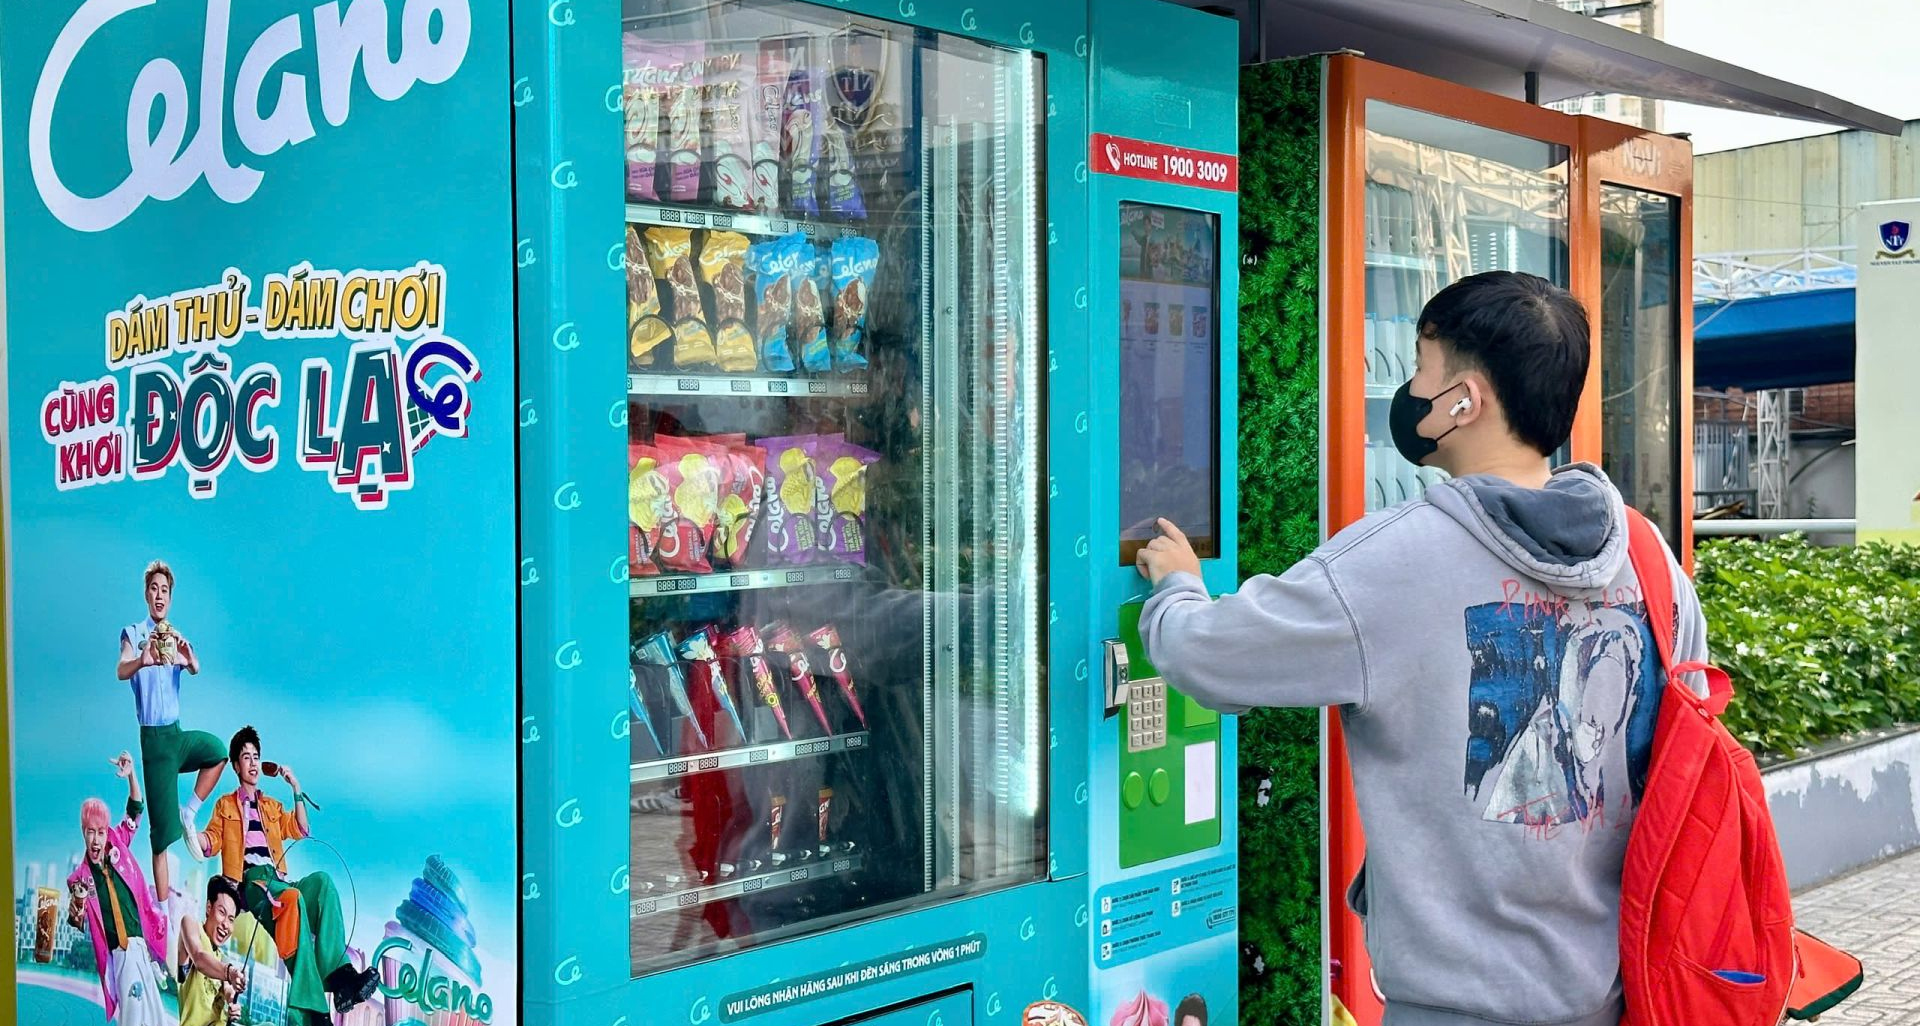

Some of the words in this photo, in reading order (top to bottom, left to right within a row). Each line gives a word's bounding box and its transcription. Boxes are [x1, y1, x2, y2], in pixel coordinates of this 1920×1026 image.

[29, 0, 471, 232] Celano
[1124, 152, 1158, 171] HOTLINE
[1162, 154, 1194, 179] 1900
[1197, 160, 1228, 183] 3009
[110, 302, 169, 362] DÁM
[174, 275, 246, 344] THỬ
[265, 269, 339, 330] DÁM
[341, 269, 440, 334] CHƠI
[60, 432, 122, 483] KHƠI
[132, 352, 277, 491] ĐỘC
[304, 347, 408, 502] LẠ
[1496, 577, 1573, 631] PINK
[372, 937, 492, 1025] Celano
[727, 1000, 743, 1015] VUI
[827, 975, 843, 990] SAU
[845, 971, 859, 985] KHI
[902, 953, 930, 970] TRONG
[955, 946, 960, 957] 1
